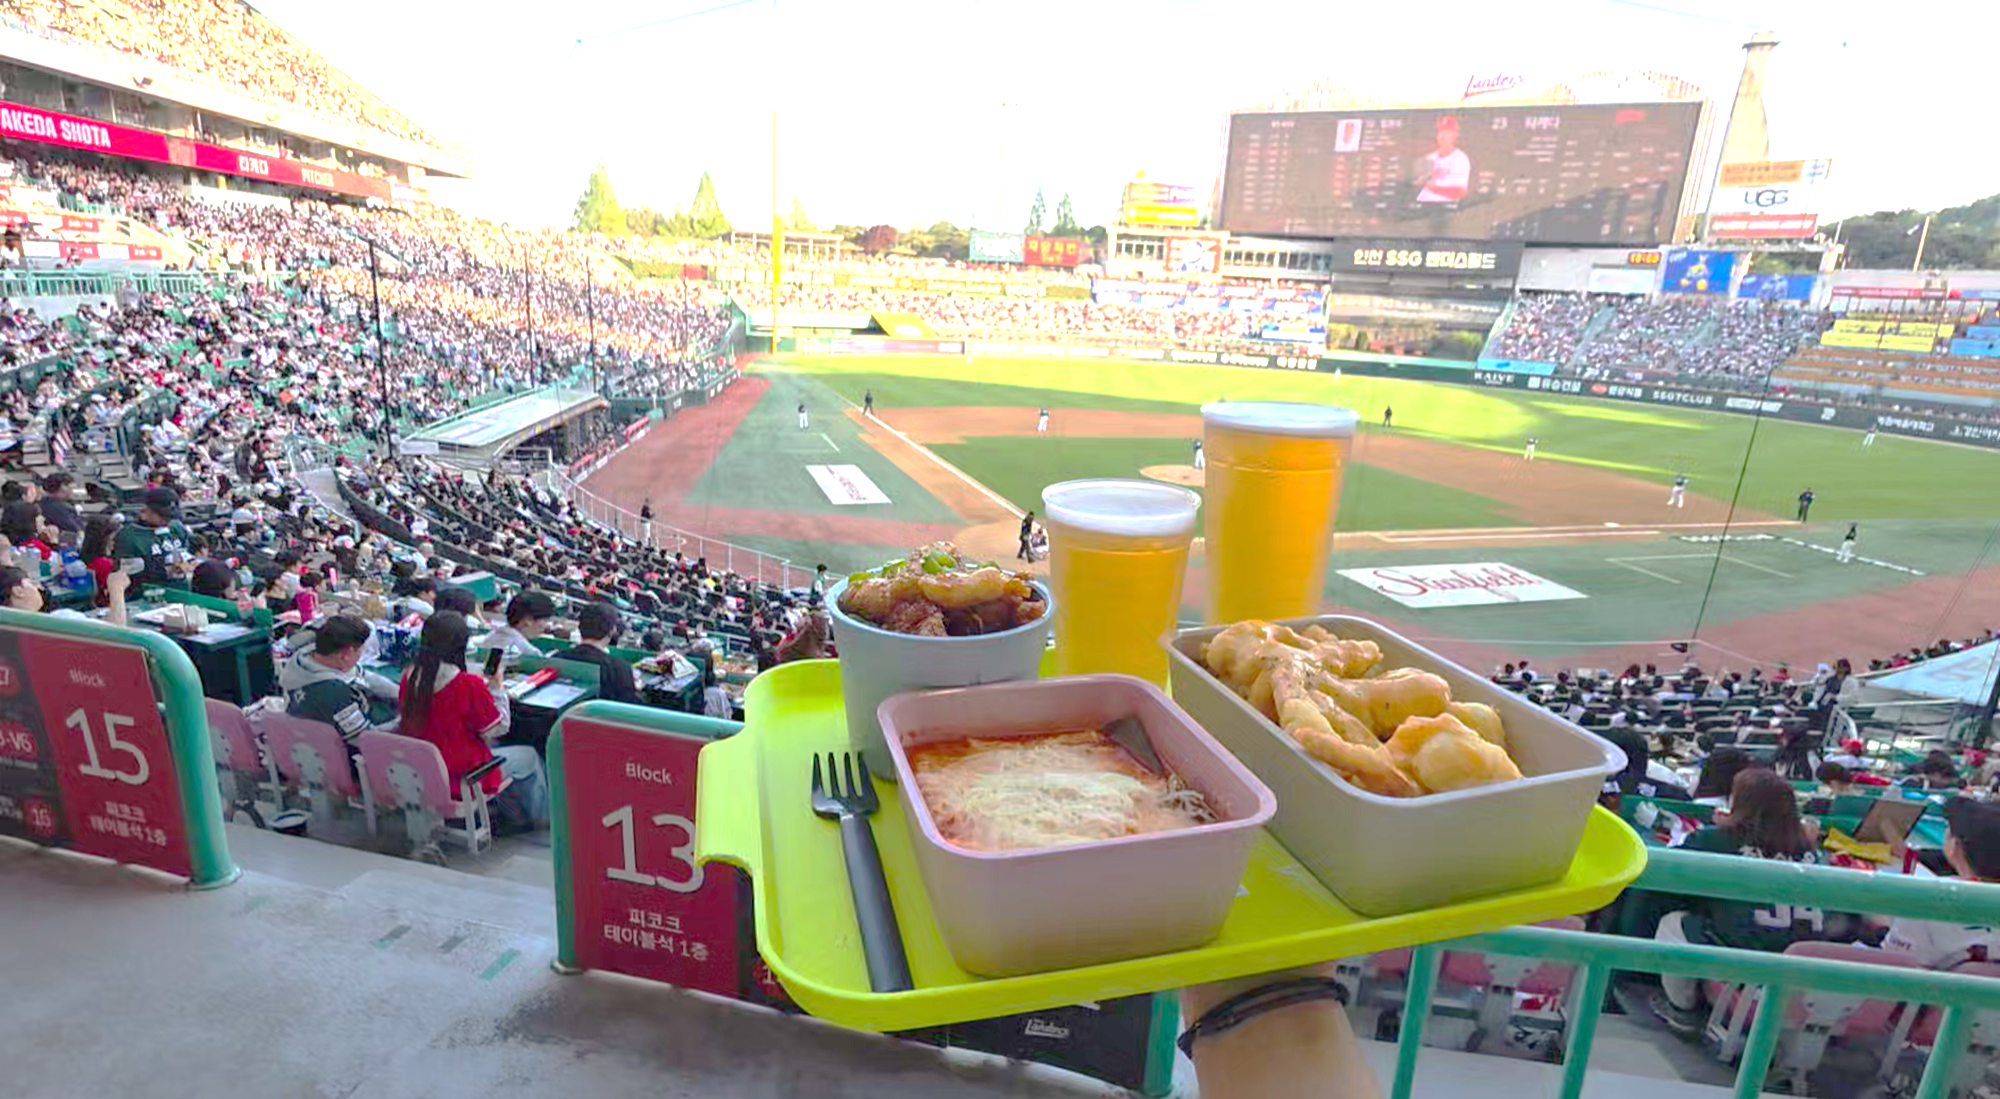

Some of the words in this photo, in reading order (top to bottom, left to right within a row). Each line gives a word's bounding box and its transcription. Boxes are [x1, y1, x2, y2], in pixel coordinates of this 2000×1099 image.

[1, 108, 57, 138] AKEDA
[60, 119, 111, 148] SHOTA
[1744, 189, 1789, 207] UGG
[1354, 249, 1383, 265] 인천
[1385, 249, 1423, 267] SSG
[1425, 251, 1496, 269] 랜더스필드
[70, 669, 106, 688] Block
[65, 708, 149, 785] 15
[625, 761, 672, 785] Block
[602, 804, 705, 893] 13
[629, 908, 683, 934] 피코크
[604, 924, 674, 953] 테이블석
[680, 939, 709, 961] 1층
